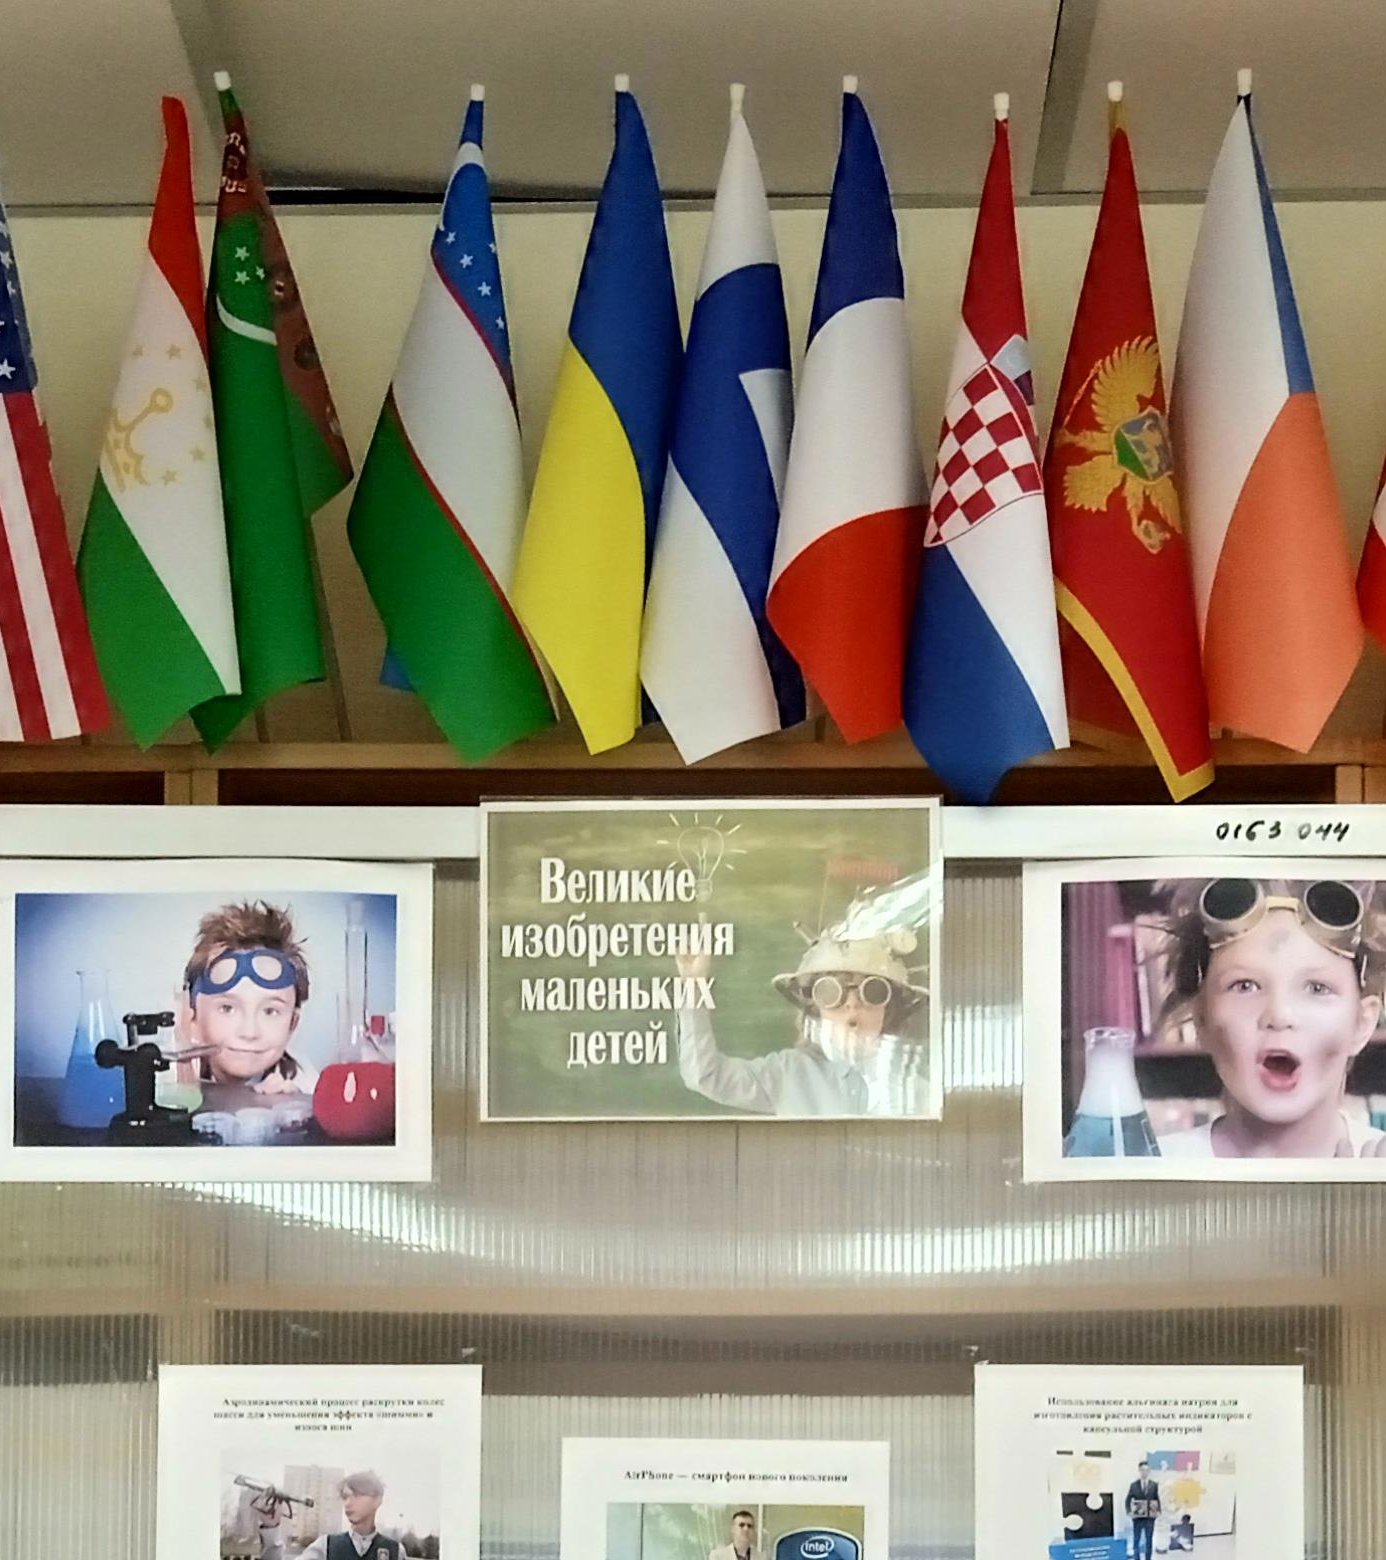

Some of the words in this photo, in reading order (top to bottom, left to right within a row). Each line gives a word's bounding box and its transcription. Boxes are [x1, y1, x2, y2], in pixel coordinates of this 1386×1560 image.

[540, 856, 696, 904] Великие
[501, 912, 734, 967] изобретения
[521, 976, 716, 1011] маленьких
[567, 1022, 668, 1068] детей
